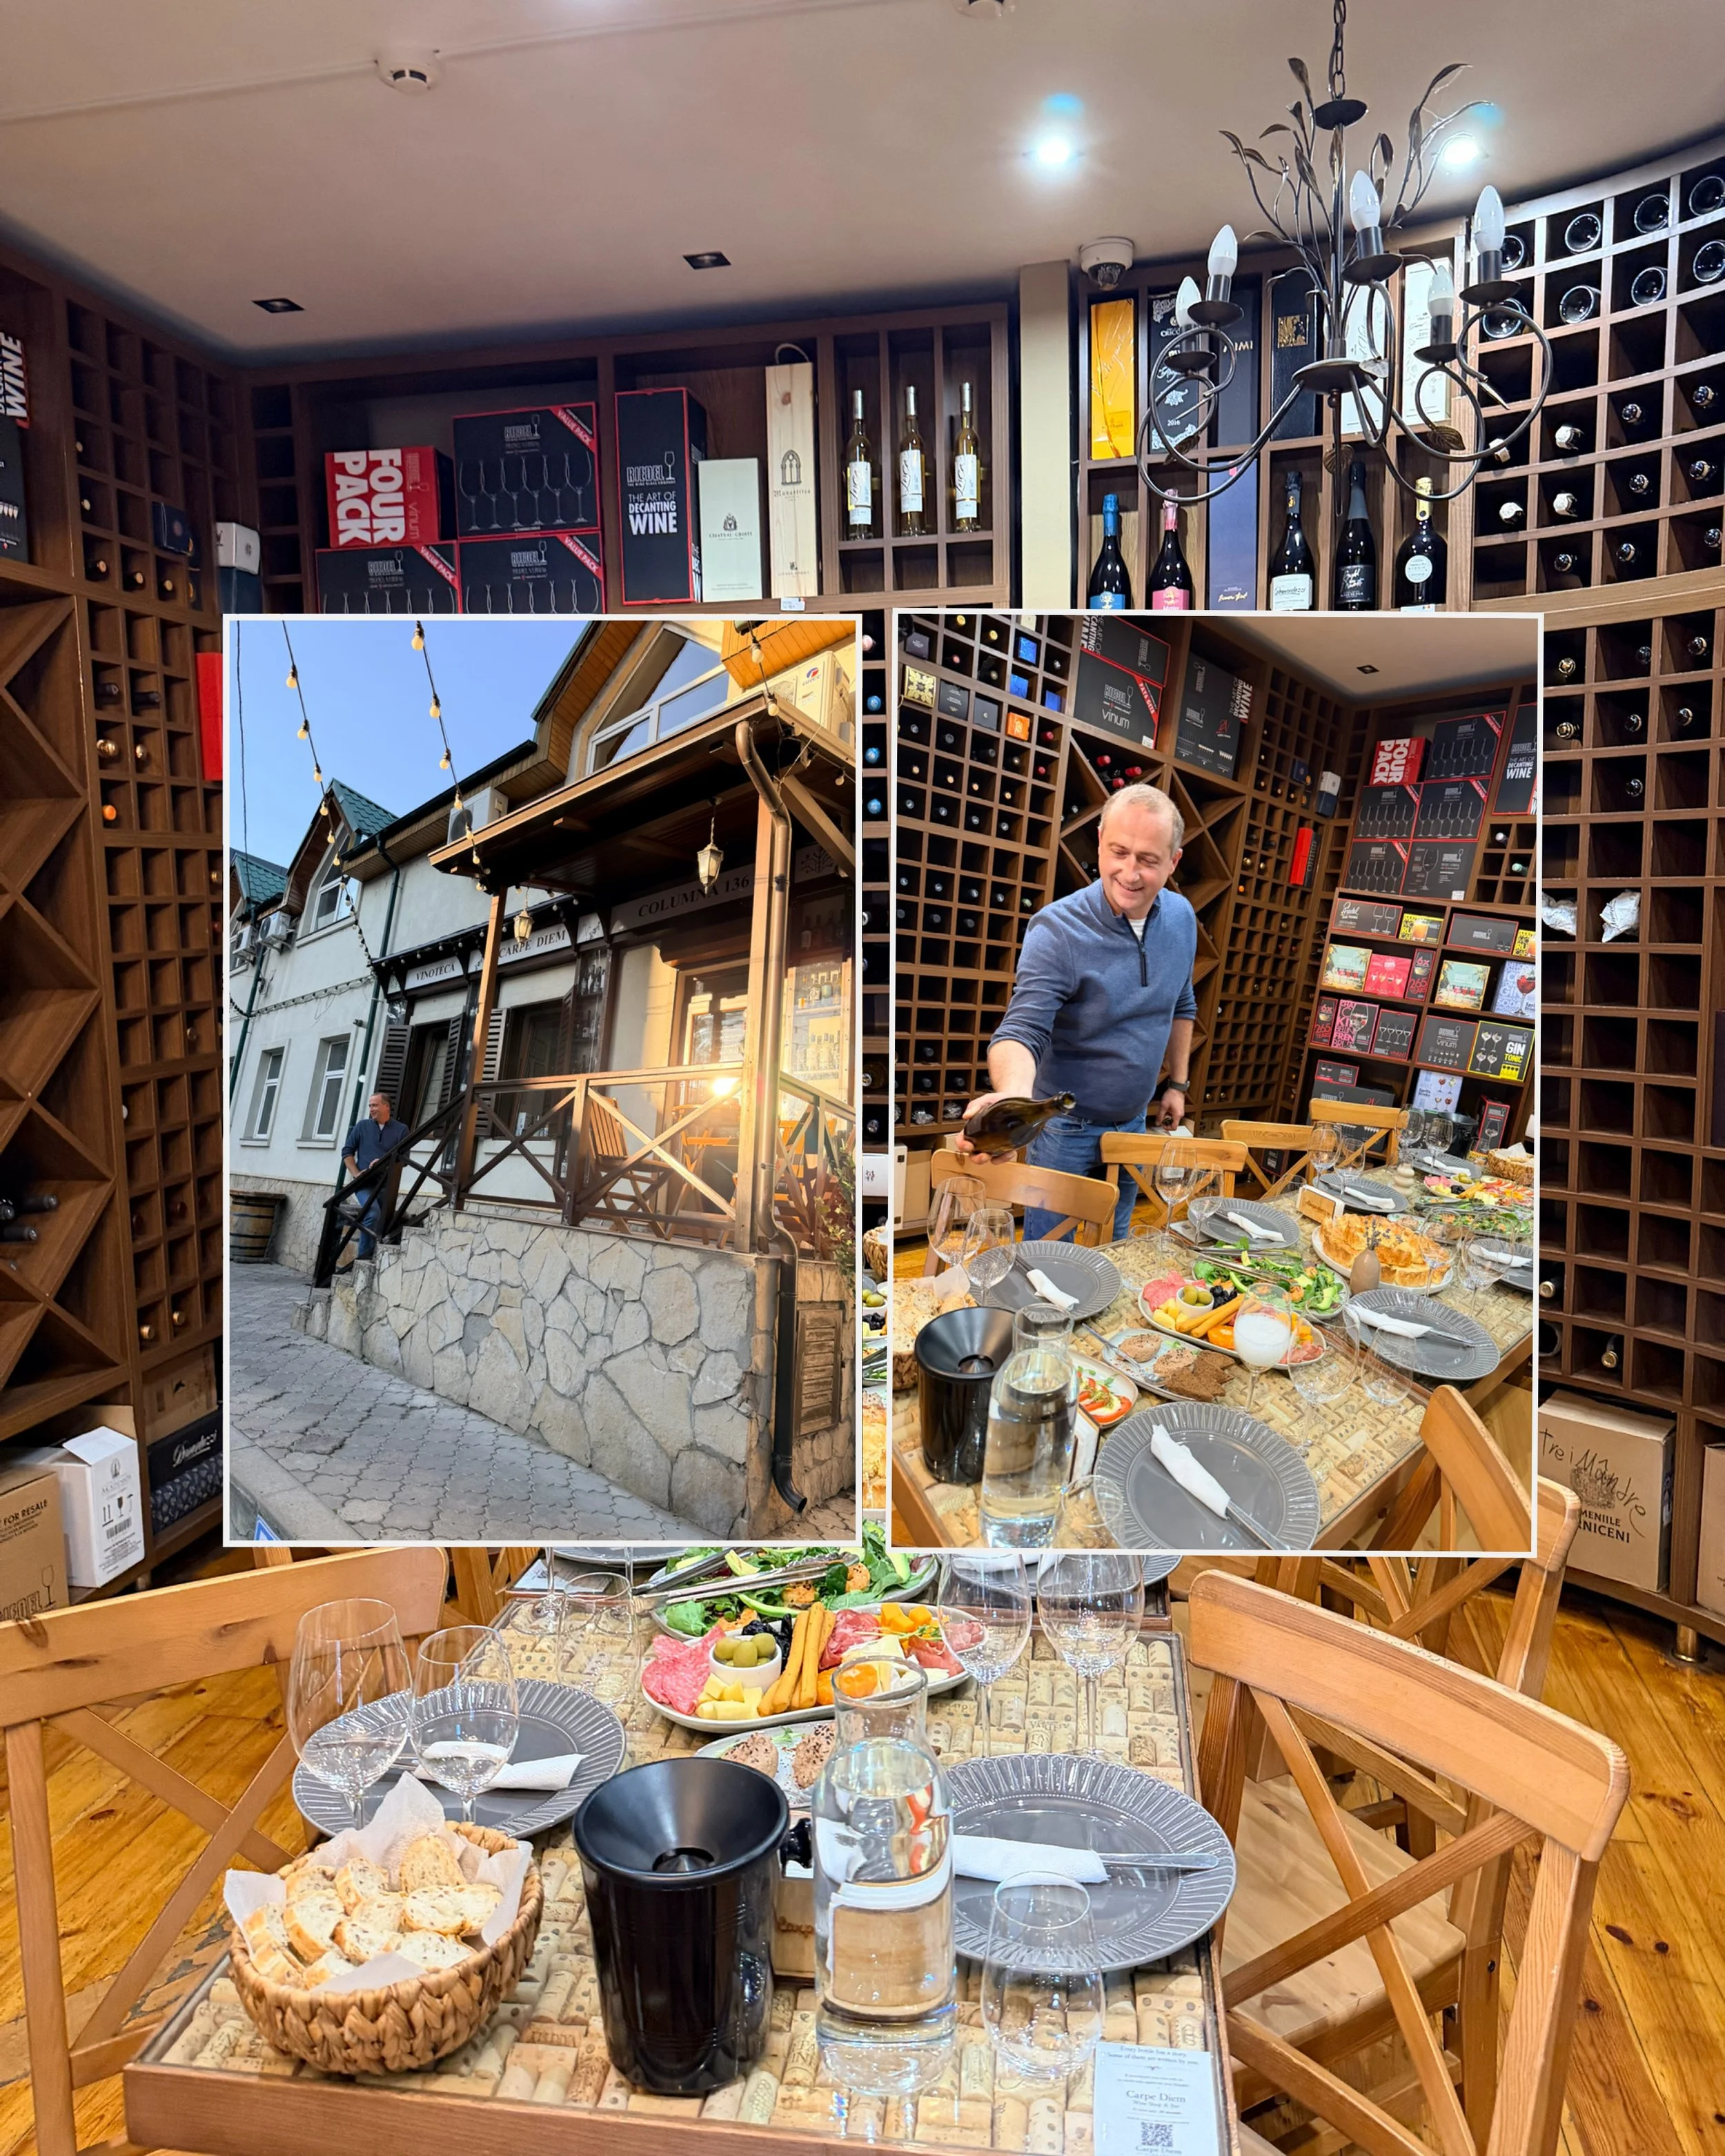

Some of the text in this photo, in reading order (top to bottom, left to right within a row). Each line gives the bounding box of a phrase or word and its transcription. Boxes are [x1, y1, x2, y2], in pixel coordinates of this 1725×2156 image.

[1223, 341, 1254, 353] IMI
[575, 428, 592, 446] PACK
[627, 465, 664, 482] RIEDEL
[334, 451, 373, 546] PACK
[369, 449, 406, 544] FOUR
[628, 491, 676, 503] THE ART OF
[629, 500, 676, 514] DECANTING
[629, 512, 678, 535] WINE
[436, 564, 455, 582] PACK
[580, 555, 599, 573] PACK
[1233, 679, 1244, 717] DECANTING
[1239, 681, 1253, 720] WINE
[1102, 709, 1130, 729] vinum
[1373, 740, 1395, 784] PACK
[1388, 738, 1410, 784] FOUR
[1506, 767, 1532, 780] WINE
[638, 874, 750, 918] COLUMNA 136
[499, 929, 566, 958] CARPE DIEM
[416, 962, 455, 982] VINOTECA
[1321, 1004, 1332, 1013] 6x
[1314, 1023, 1331, 1034] 265
[1506, 1042, 1526, 1056] GIN
[1504, 1054, 1524, 1063] TONIC
[3, 1499, 48, 1526] FOR RESALE
[1581, 1510, 1621, 1527] MENIILE
[1, 1590, 42, 1621] IEDEL
[1126, 2090, 1186, 2103] Carpe Diem
[1135, 2144, 1159, 2153] Carpe
